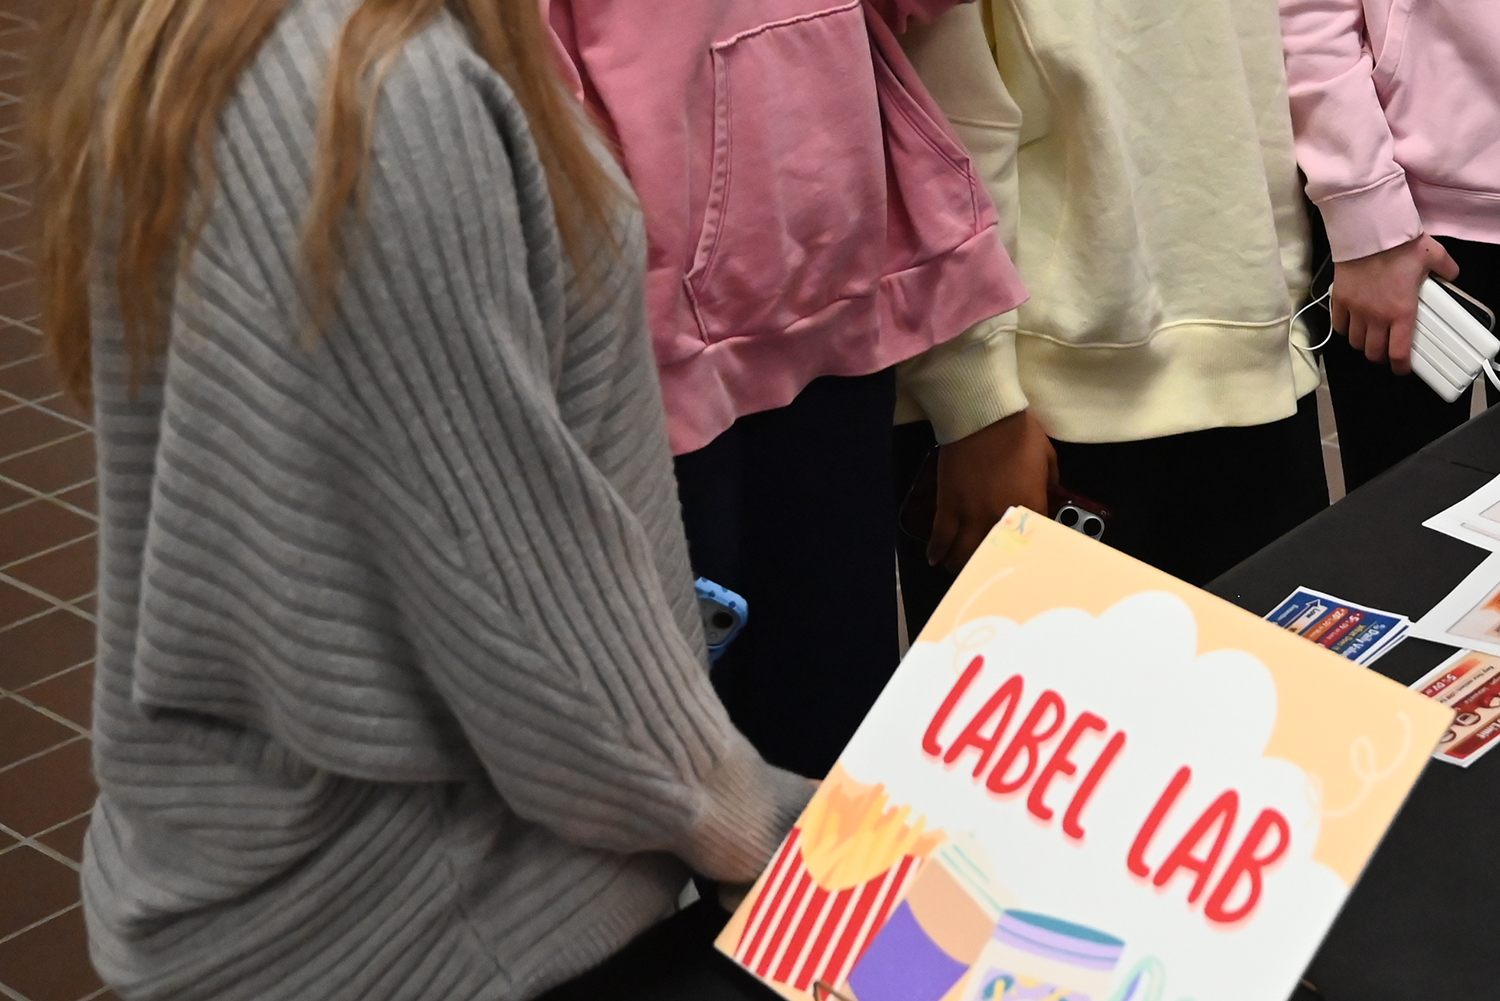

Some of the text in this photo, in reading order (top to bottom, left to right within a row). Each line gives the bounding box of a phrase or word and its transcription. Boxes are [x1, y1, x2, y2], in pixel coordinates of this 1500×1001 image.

[1305, 608, 1319, 618] Low
[1355, 628, 1379, 643] Daily
[1476, 722, 1500, 738] Limit
[922, 654, 1291, 924] LABEL LAB
